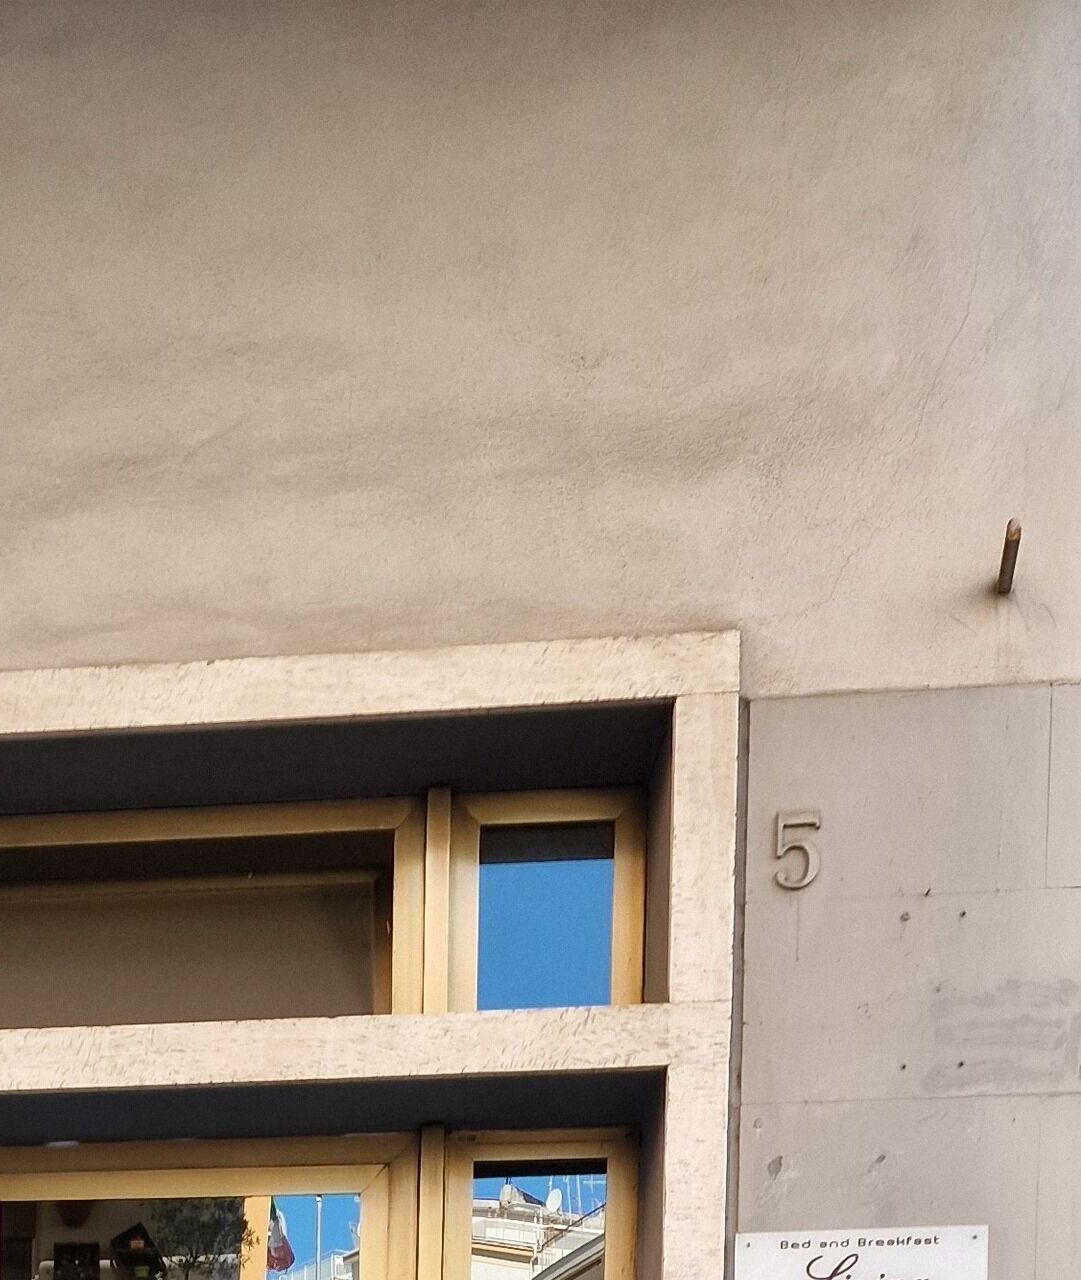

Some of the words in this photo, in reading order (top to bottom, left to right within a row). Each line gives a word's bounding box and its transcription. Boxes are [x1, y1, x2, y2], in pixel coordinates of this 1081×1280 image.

[774, 811, 820, 892] 5
[780, 1240, 811, 1249] Bed
[819, 1238, 850, 1248] and
[858, 1236, 941, 1248] Breakfast
